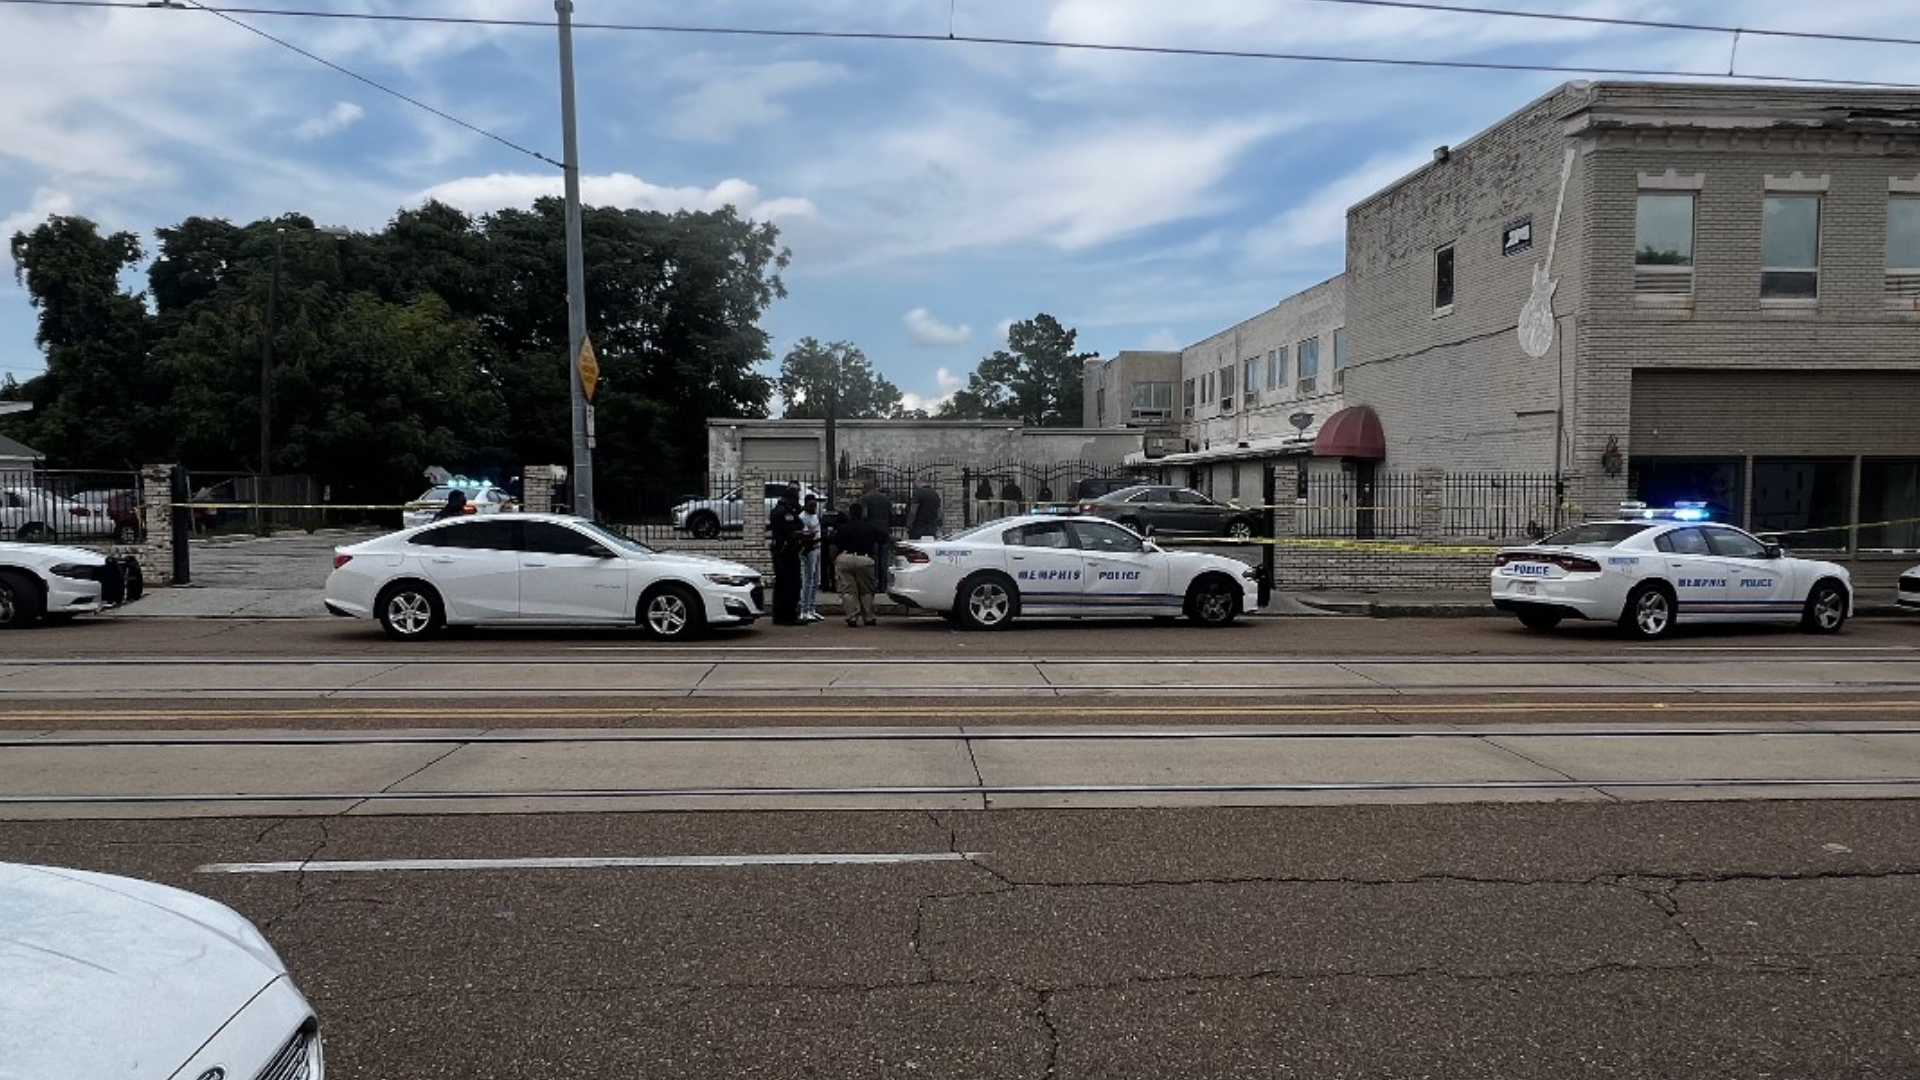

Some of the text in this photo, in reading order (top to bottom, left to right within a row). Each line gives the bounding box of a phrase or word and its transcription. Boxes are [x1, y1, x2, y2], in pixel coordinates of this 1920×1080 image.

[1514, 564, 1550, 575] POLICE
[1018, 570, 1141, 580] MEMPHIS POLICE
[1678, 578, 1773, 587] MEMPHIS POLICE
